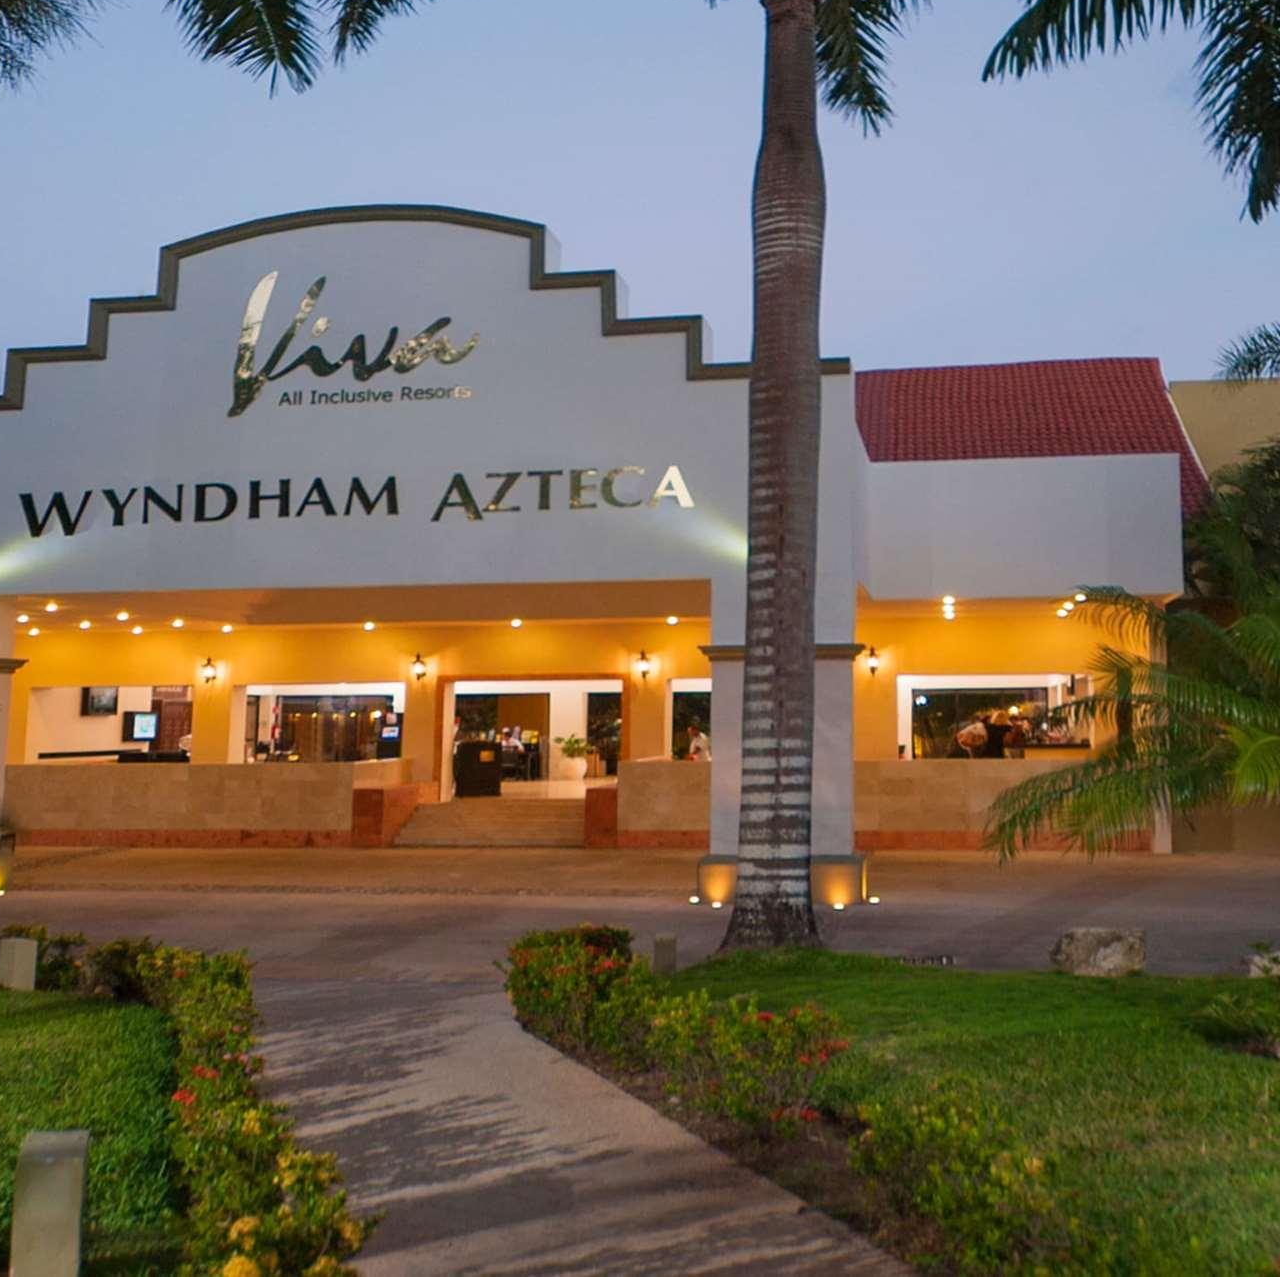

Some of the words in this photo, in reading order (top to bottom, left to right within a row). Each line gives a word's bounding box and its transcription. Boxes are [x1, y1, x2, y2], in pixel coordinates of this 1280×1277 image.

[227, 270, 480, 417] Viva
[278, 391, 303, 406] All
[310, 388, 393, 405] Inclusive
[400, 384, 471, 401] Resorts
[19, 476, 399, 538] WYNDHAM
[431, 465, 695, 522] AZTECA
